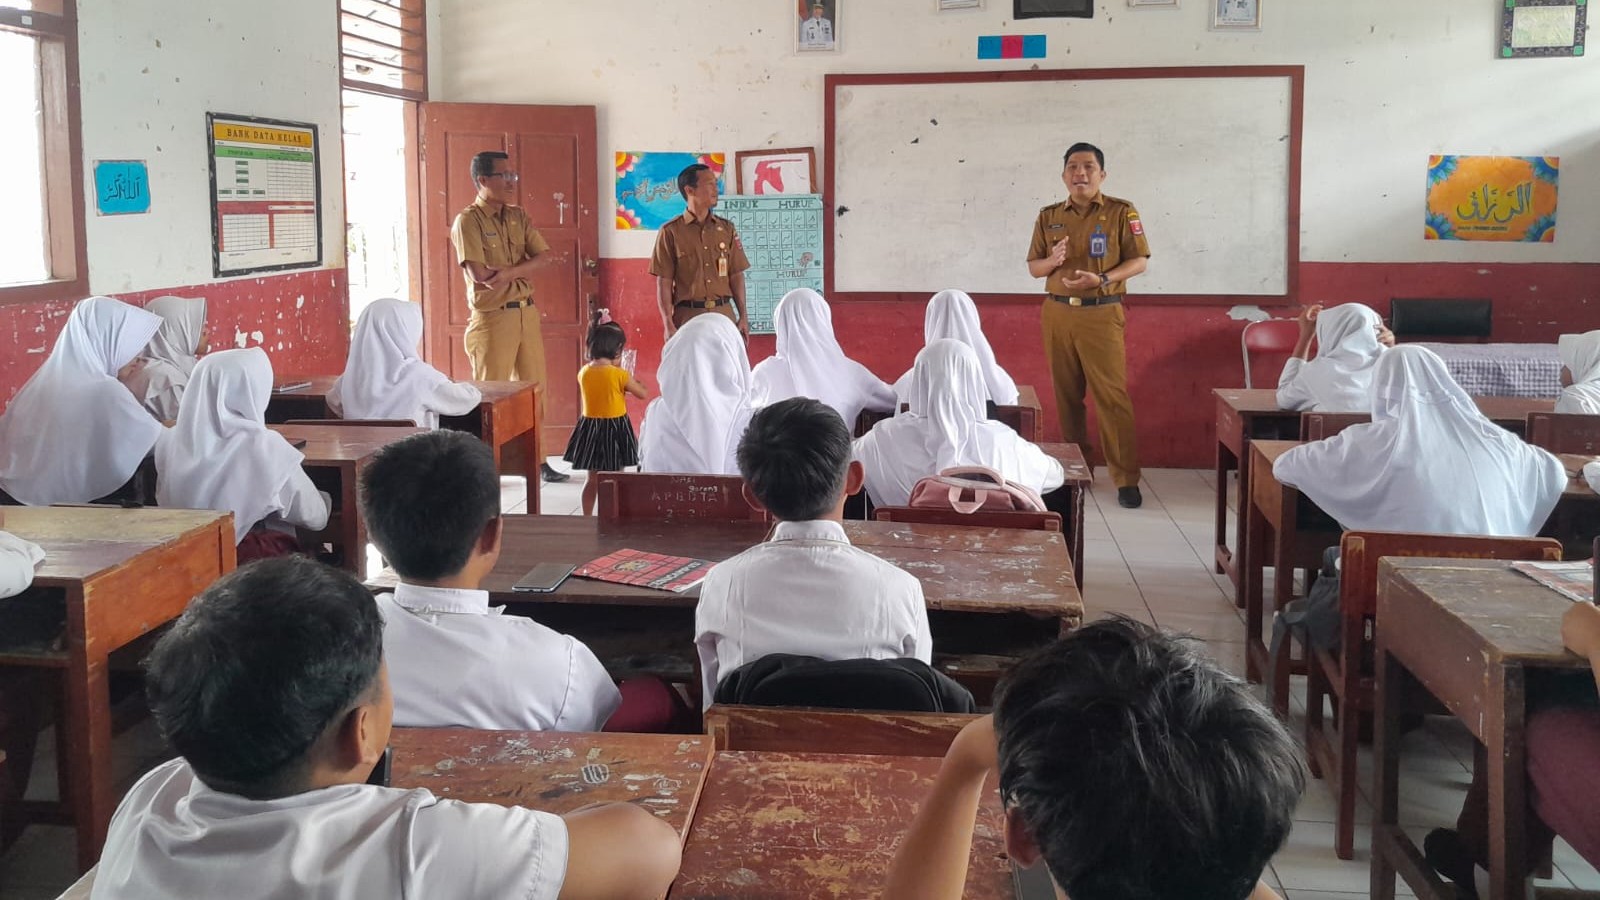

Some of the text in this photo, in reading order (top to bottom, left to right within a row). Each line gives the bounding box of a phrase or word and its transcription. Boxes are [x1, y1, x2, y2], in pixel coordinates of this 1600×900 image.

[227, 128, 249, 138] BANK
[253, 131, 274, 141] DATA
[778, 200, 814, 209] HURUF
